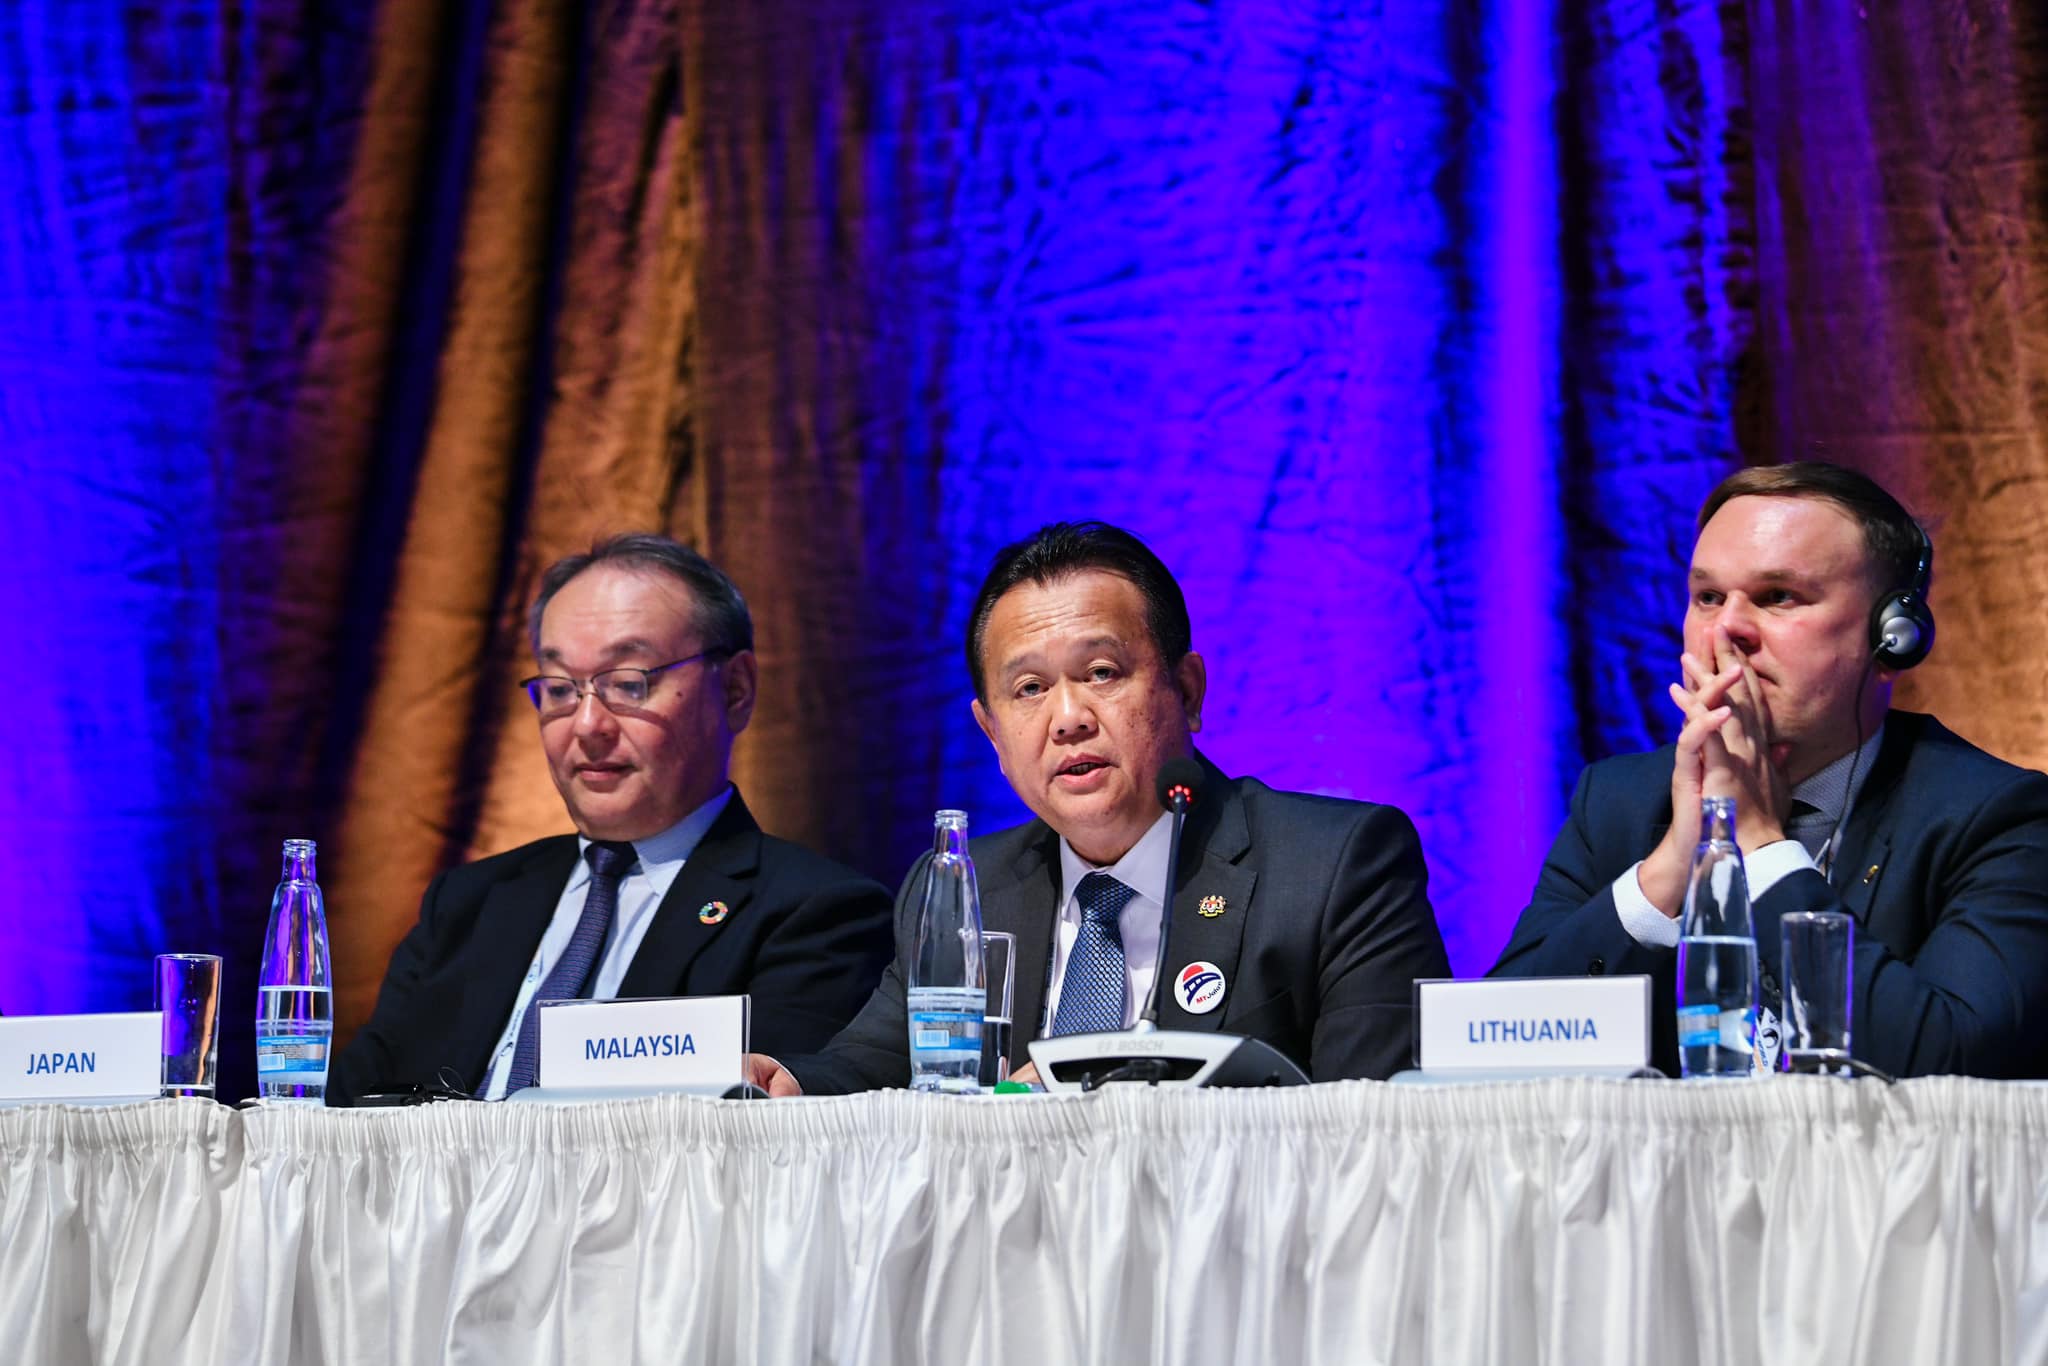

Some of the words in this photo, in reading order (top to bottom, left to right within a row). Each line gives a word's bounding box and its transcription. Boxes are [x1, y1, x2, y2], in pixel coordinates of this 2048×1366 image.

[1468, 1017, 1598, 1043] LITHUANIA
[585, 1034, 695, 1060] MALAYSIA
[1117, 1040, 1164, 1052] BOSCH
[26, 1052, 95, 1075] JAPAN
